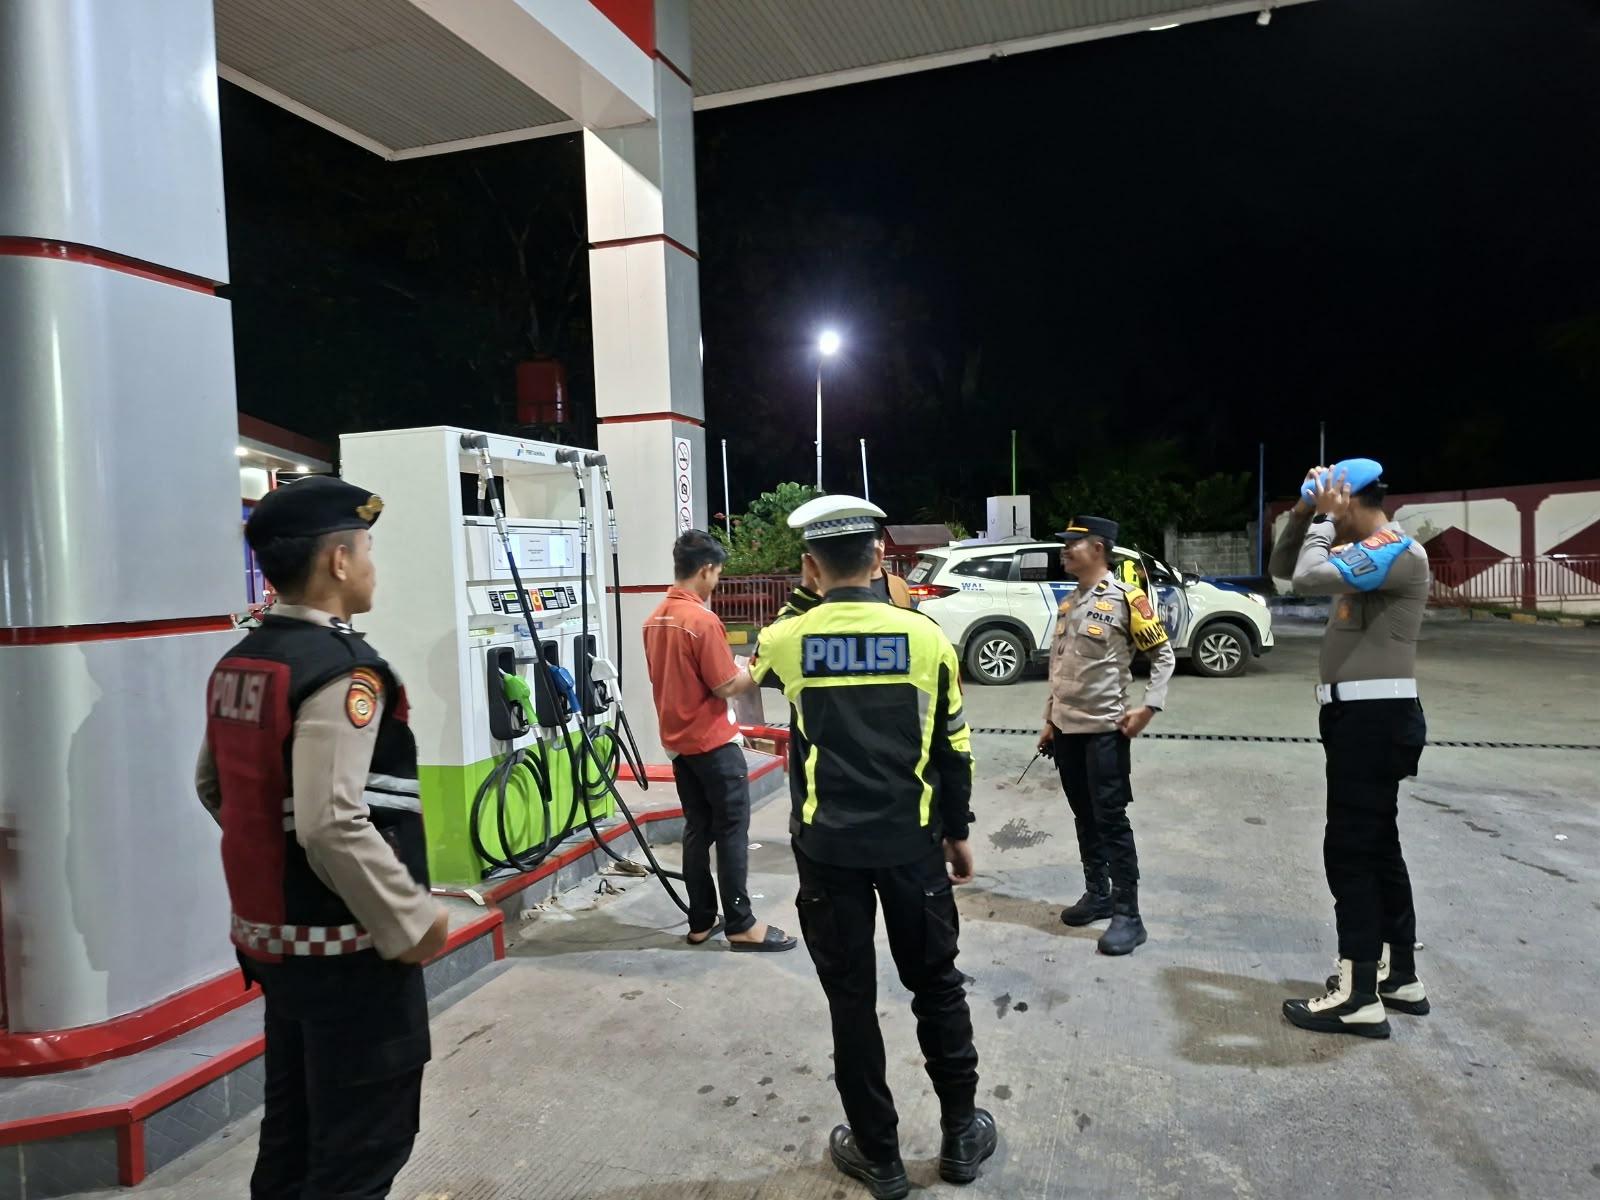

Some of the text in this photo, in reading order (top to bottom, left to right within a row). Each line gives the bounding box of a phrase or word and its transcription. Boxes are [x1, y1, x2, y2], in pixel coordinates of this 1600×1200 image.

[1087, 610, 1114, 623] POLRI
[805, 637, 907, 672] POLISI
[210, 671, 267, 723] POLISI
